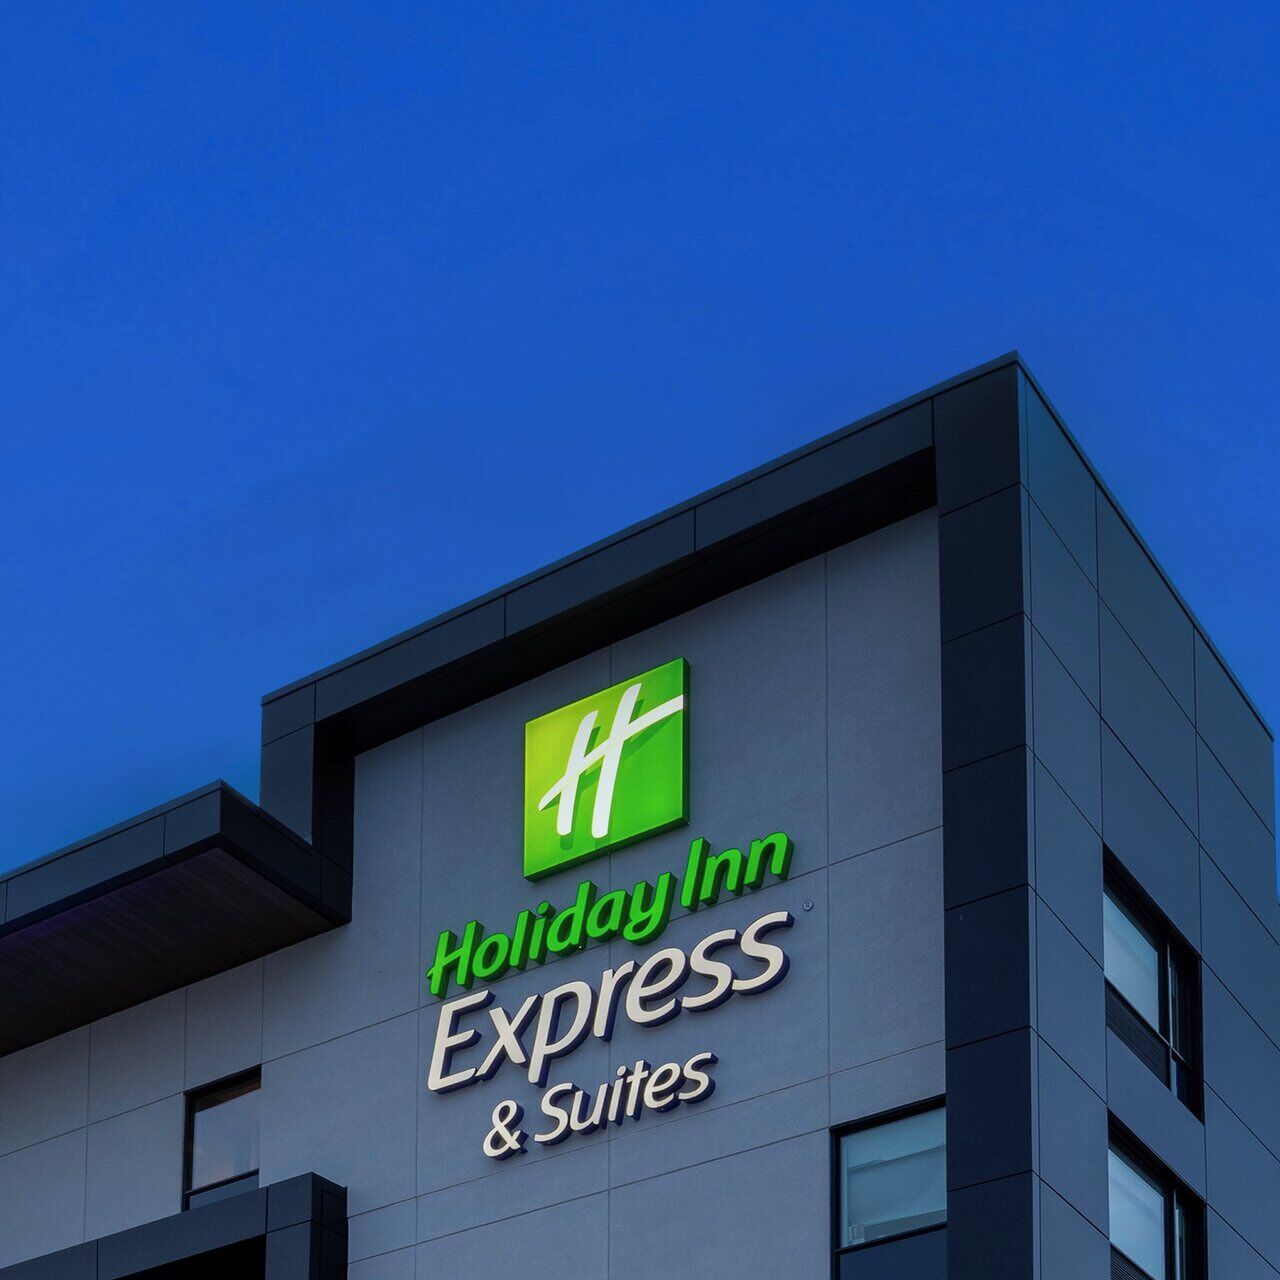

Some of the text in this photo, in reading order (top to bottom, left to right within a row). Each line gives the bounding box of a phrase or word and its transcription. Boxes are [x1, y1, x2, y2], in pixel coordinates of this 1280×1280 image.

[425, 831, 794, 998] Holiday Inn
[427, 911, 795, 1094] Express
[482, 1052, 718, 1160] & Suites
